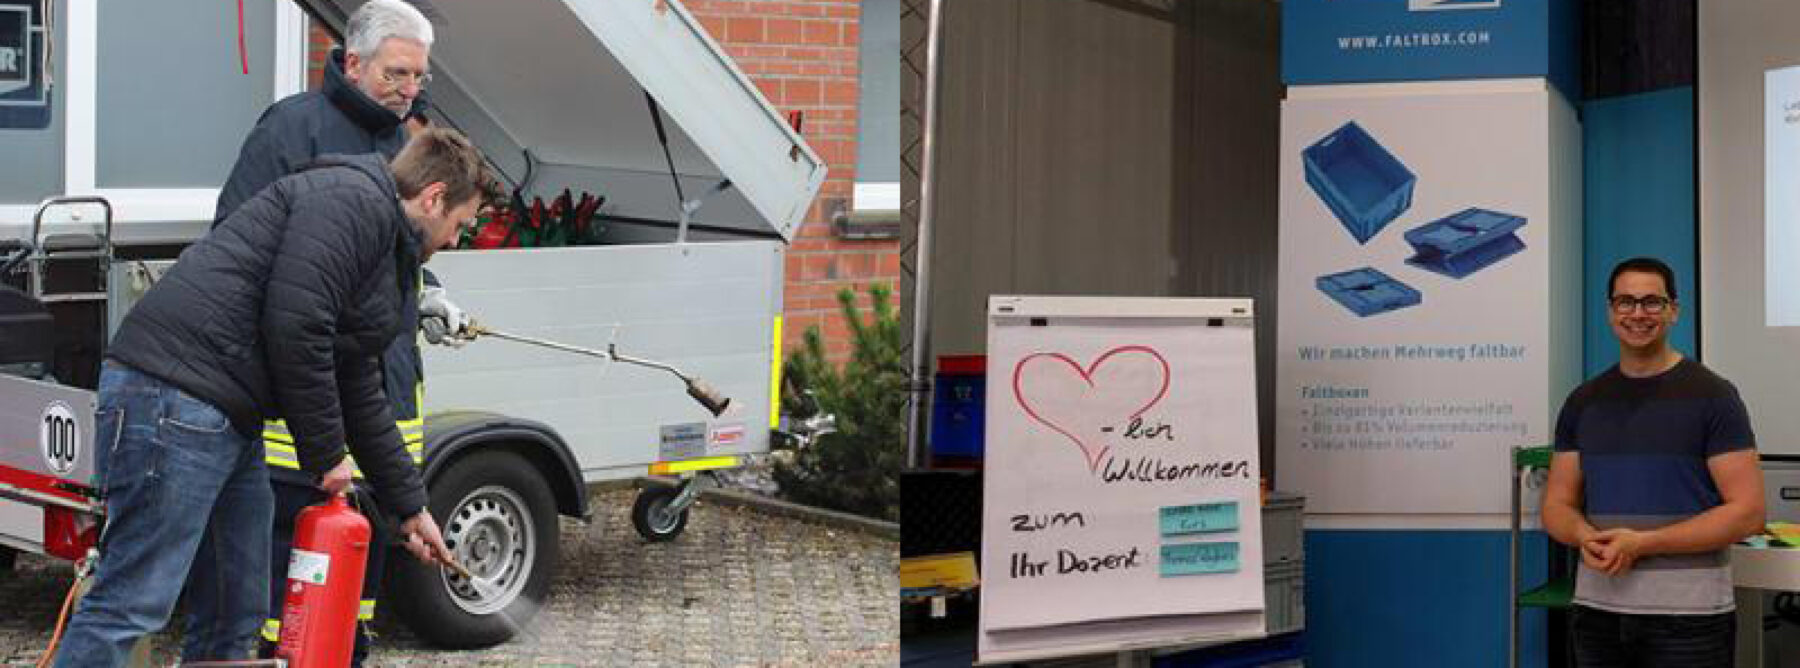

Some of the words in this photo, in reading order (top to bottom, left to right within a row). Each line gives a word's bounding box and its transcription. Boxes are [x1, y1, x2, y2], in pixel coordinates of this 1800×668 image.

[1338, 31, 1490, 49] WWW.FALTBOX.COM
[1298, 345, 1325, 360] Wir
[1330, 345, 1390, 360] machen
[1395, 345, 1465, 361] Mehrweg
[1470, 343, 1526, 359] faltbar
[1301, 386, 1369, 399] Faltboxen
[45, 415, 74, 462] 100
[1102, 456, 1249, 483] Willkommen
[1010, 511, 1085, 531] zum
[1010, 552, 1049, 578] Ihr
